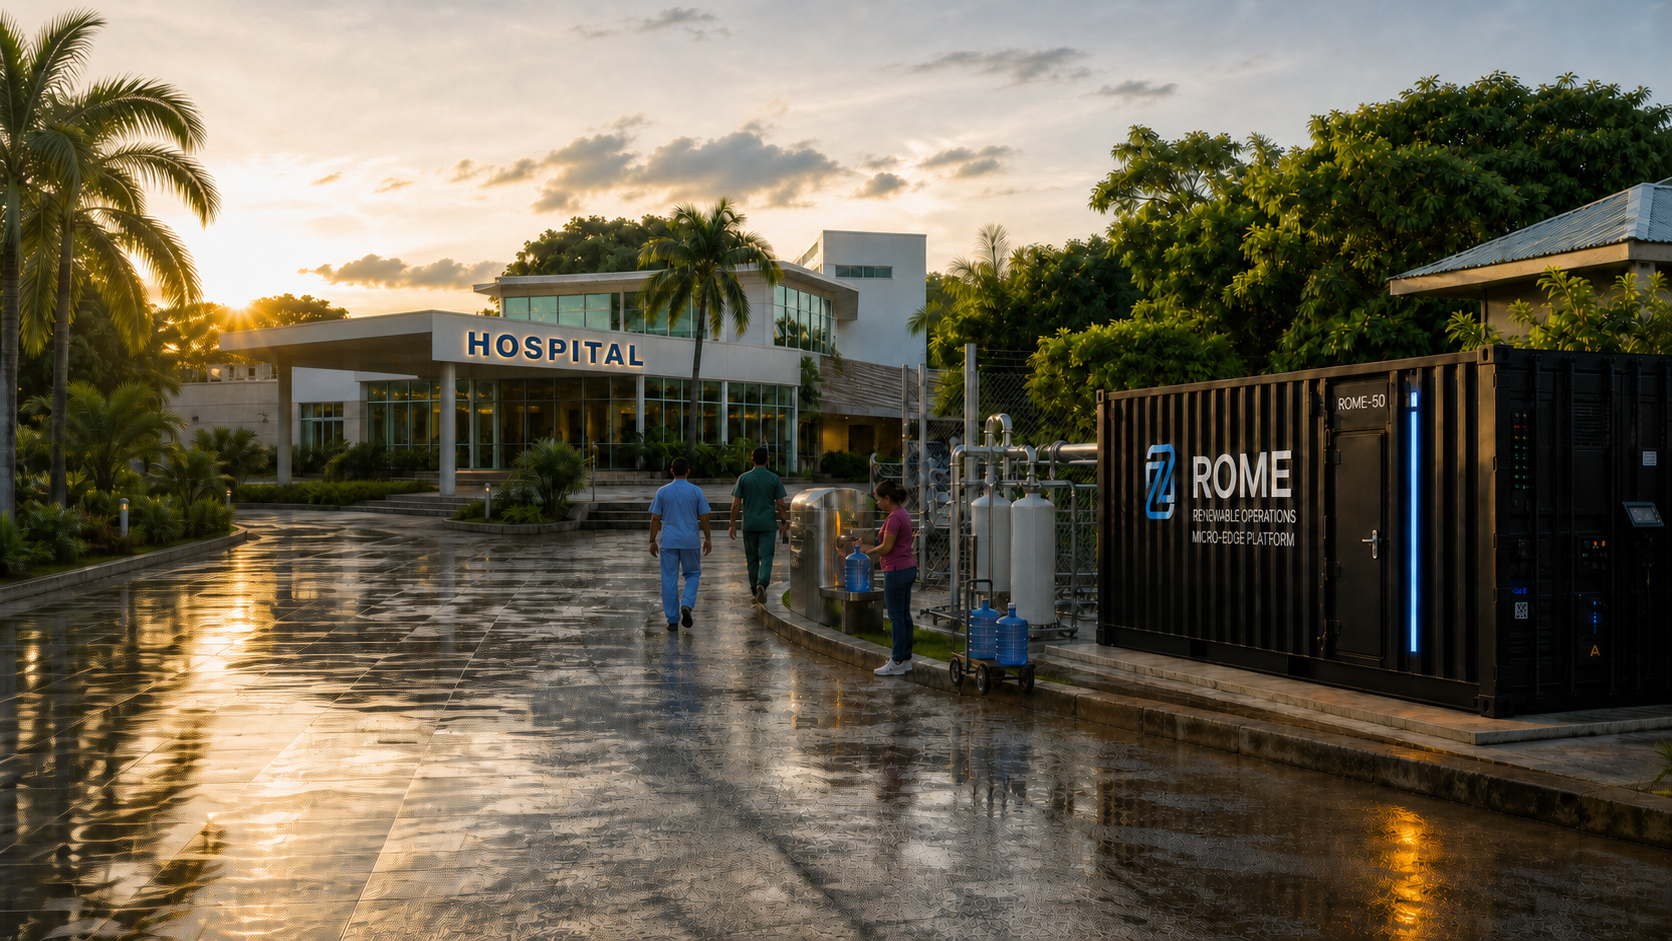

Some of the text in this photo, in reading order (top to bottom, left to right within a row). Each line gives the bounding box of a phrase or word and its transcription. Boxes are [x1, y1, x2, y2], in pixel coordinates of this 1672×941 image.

[467, 331, 644, 367] HOSPITAL
[1338, 394, 1386, 410] ROME-50
[1192, 450, 1292, 499] ROME
[1192, 509, 1297, 524] RENEWABLE OPERATIONS
[1192, 530, 1295, 547] MICRO-EDGE PLATFORM
